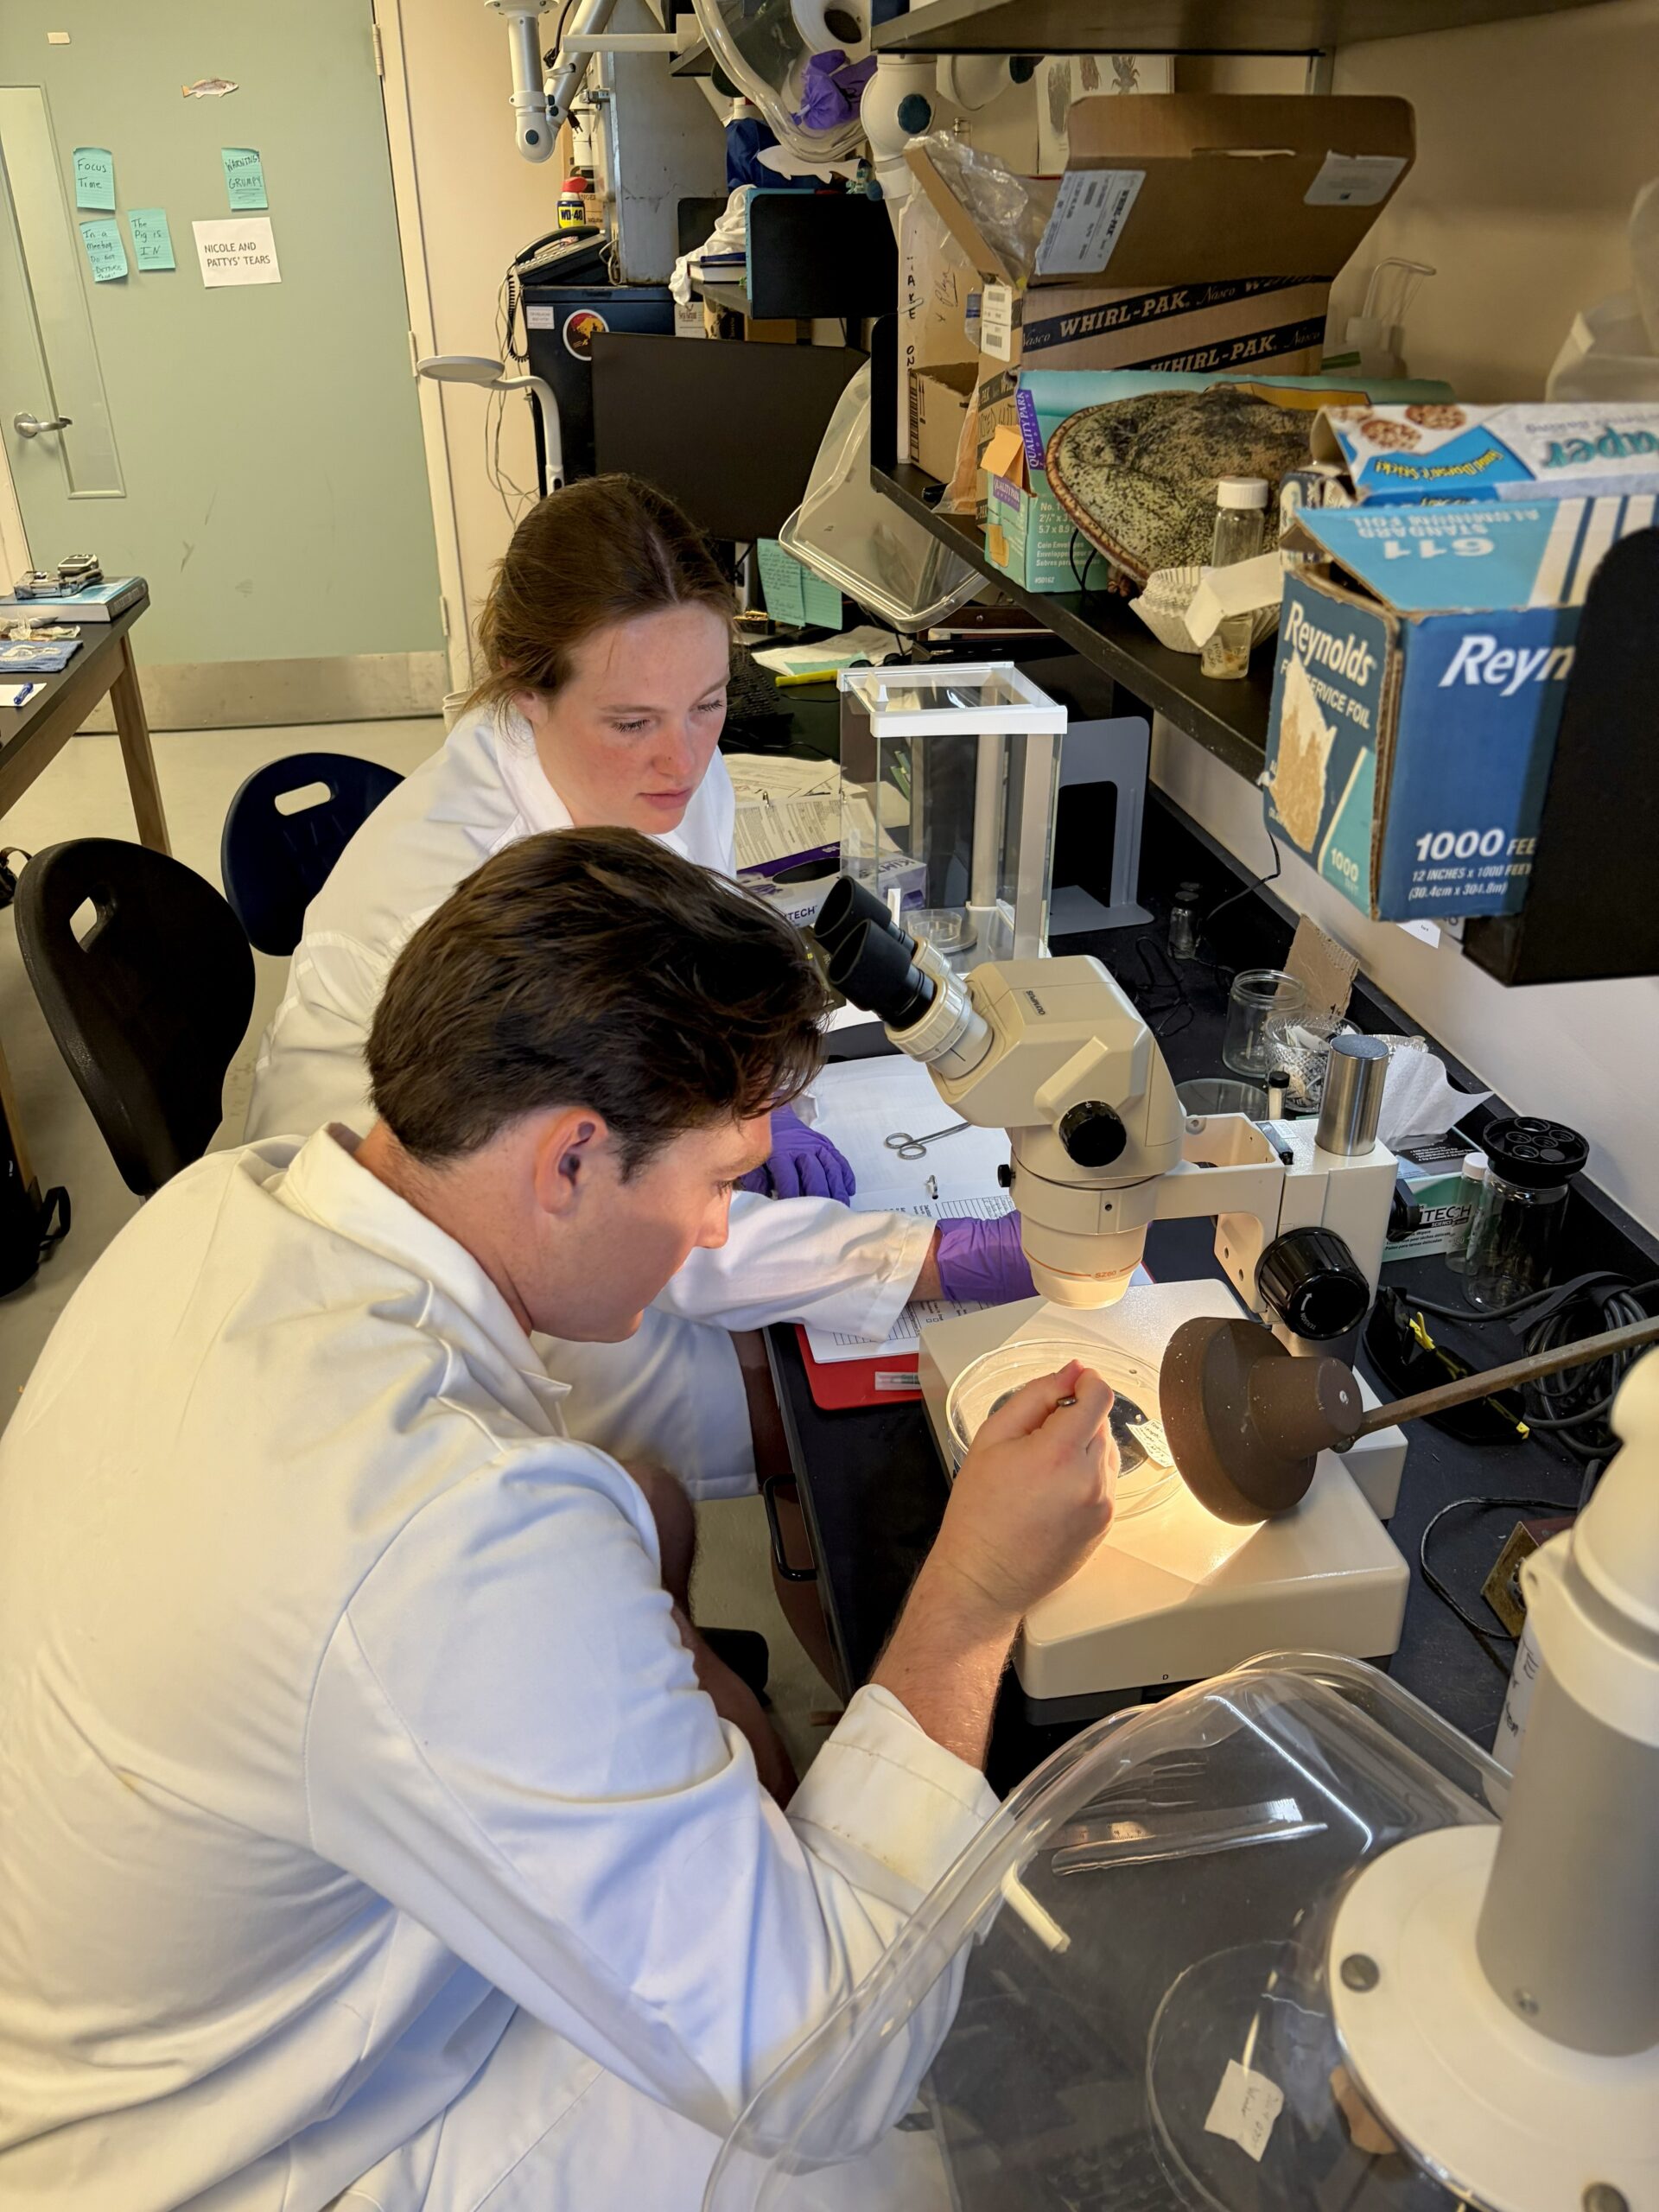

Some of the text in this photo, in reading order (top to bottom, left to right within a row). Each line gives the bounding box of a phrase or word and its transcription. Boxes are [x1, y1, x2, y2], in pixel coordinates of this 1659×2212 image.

[78, 157, 107, 173] Focus
[225, 153, 261, 172] WARNING!
[78, 177, 103, 189] Time
[228, 176, 263, 189] GRUMPY
[131, 218, 147, 228] The
[561, 209, 583, 220] WD-40
[204, 242, 257, 253] NICOLE AND
[207, 255, 270, 267] PATTYS' TEARS
[1059, 290, 1190, 338] WHIRL-PAK
[1150, 334, 1277, 372] WHIRL-PAK
[1017, 391, 1039, 468] QUALITY PARK
[1541, 426, 1659, 470] aper
[1348, 509, 1540, 528] ALUMINUM FOIL
[1358, 523, 1488, 538] STANDARD
[1384, 537, 1494, 560] 611
[1284, 600, 1372, 688] Reynolds
[1438, 634, 1576, 696] Reyn
[1345, 696, 1371, 730] FOIL
[1415, 828, 1538, 862] 1000 FEE
[1331, 847, 1359, 883] 1000
[1412, 870, 1426, 882] 12
[1427, 867, 1466, 881] INCHES
[1478, 865, 1503, 878] 1000
[786, 906, 816, 920] TECH
